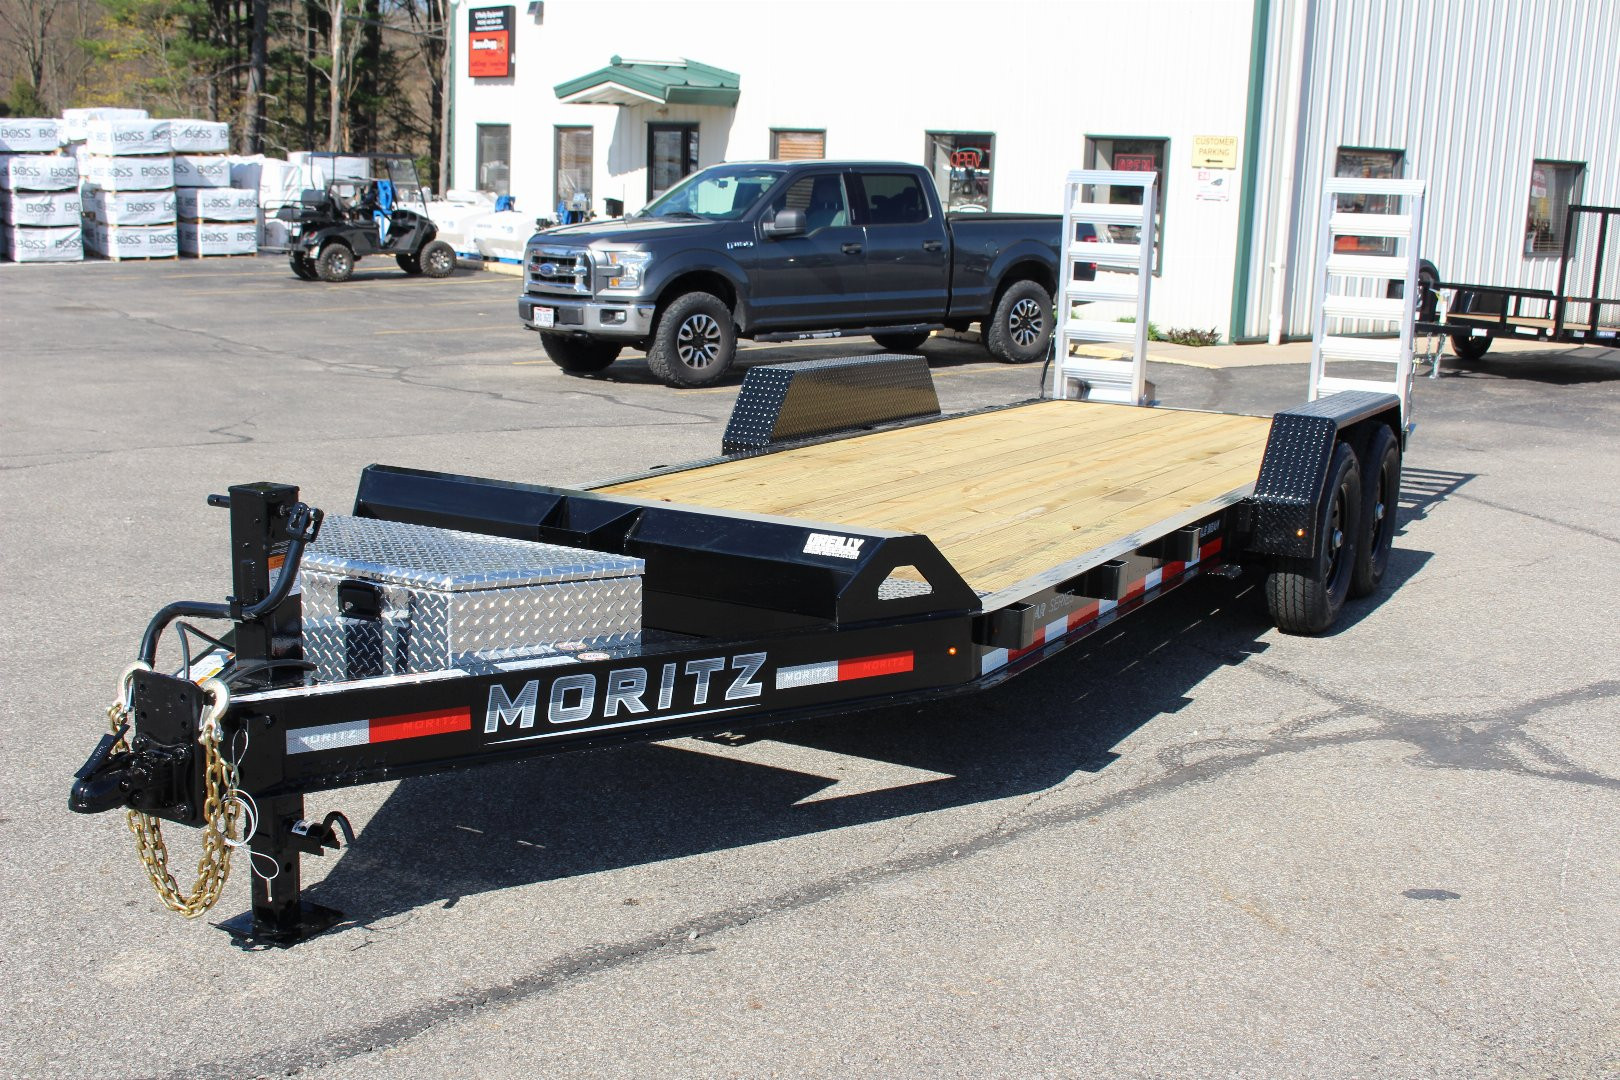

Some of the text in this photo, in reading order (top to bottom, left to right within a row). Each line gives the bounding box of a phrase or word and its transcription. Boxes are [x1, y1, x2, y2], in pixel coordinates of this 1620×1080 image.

[1, 128, 31, 138] BOSS
[114, 130, 144, 141] BOSS
[184, 129, 212, 138] BOSS
[1195, 138, 1235, 146] CUSTOMER
[1199, 148, 1230, 156] PARKING
[951, 151, 980, 168] OPEN
[141, 167, 169, 176] BOSS
[197, 165, 223, 174] BOSS
[26, 203, 56, 213] BOSS
[127, 203, 155, 212] BOSS
[863, 657, 905, 670] MORITZ
[785, 668, 829, 681] MORITZ
[484, 652, 768, 734] MORITZ
[403, 715, 459, 731] MORITZ
[301, 729, 357, 744] MORITZ
